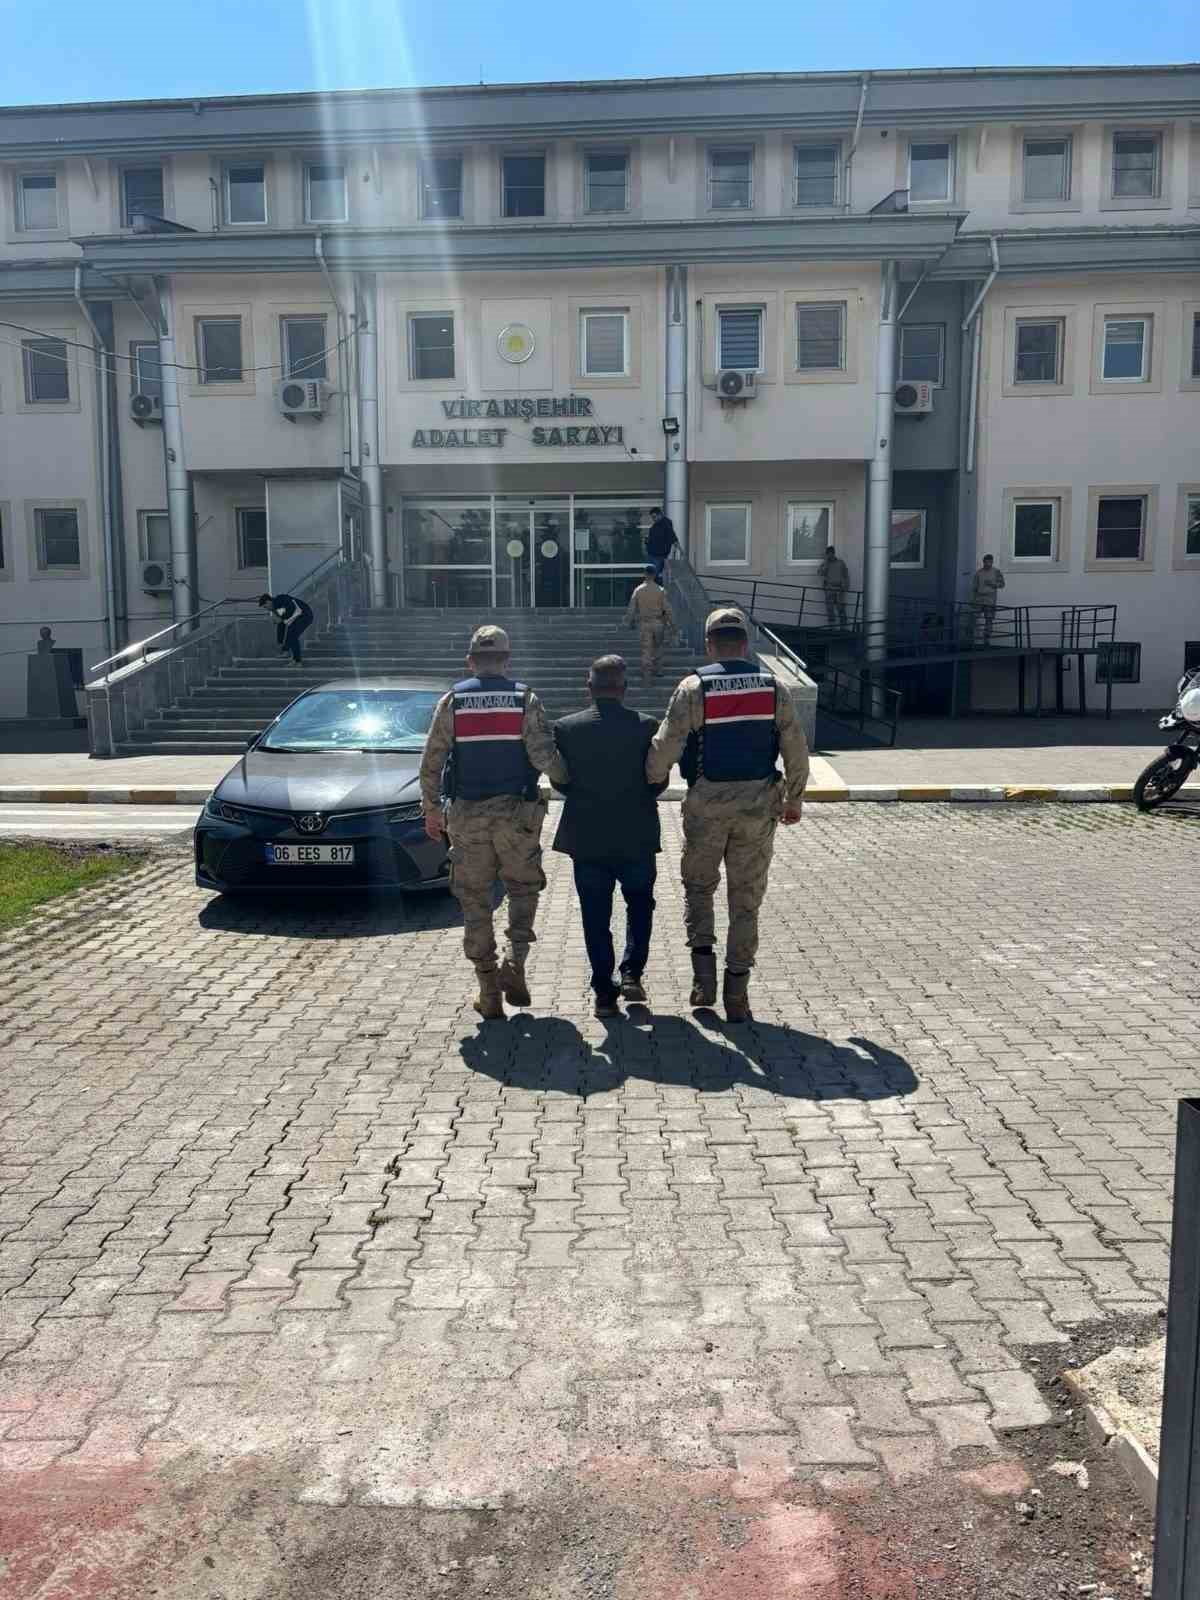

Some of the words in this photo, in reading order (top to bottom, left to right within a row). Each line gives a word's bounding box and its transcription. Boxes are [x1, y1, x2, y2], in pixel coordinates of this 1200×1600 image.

[441, 393, 592, 423] VİRANŞEHİR
[412, 428, 507, 448] ADALET
[531, 426, 624, 446] SARAYI
[710, 676, 766, 691] JANDARMA
[461, 696, 516, 709] JANDARMA
[275, 847, 290, 860] 06
[297, 847, 320, 860] EES
[331, 847, 352, 860] 817
